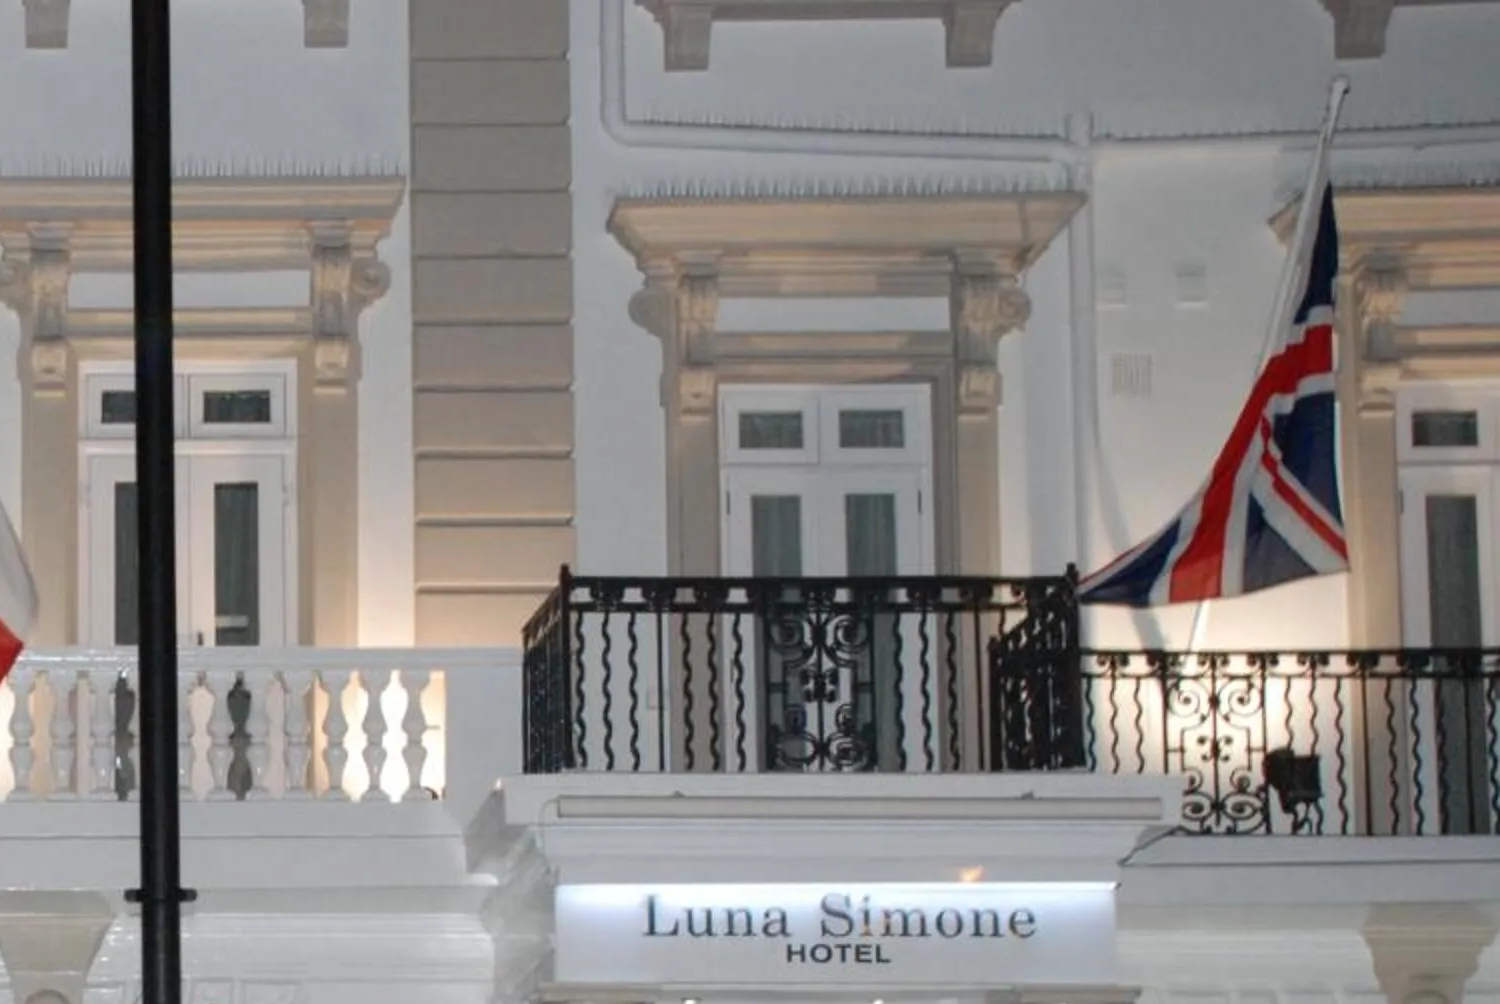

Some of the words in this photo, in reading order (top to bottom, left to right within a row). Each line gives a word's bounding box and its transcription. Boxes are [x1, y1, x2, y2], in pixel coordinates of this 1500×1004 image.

[641, 894, 790, 938] Luna
[819, 892, 1038, 939] Simone
[786, 943, 891, 963] HOTEL
